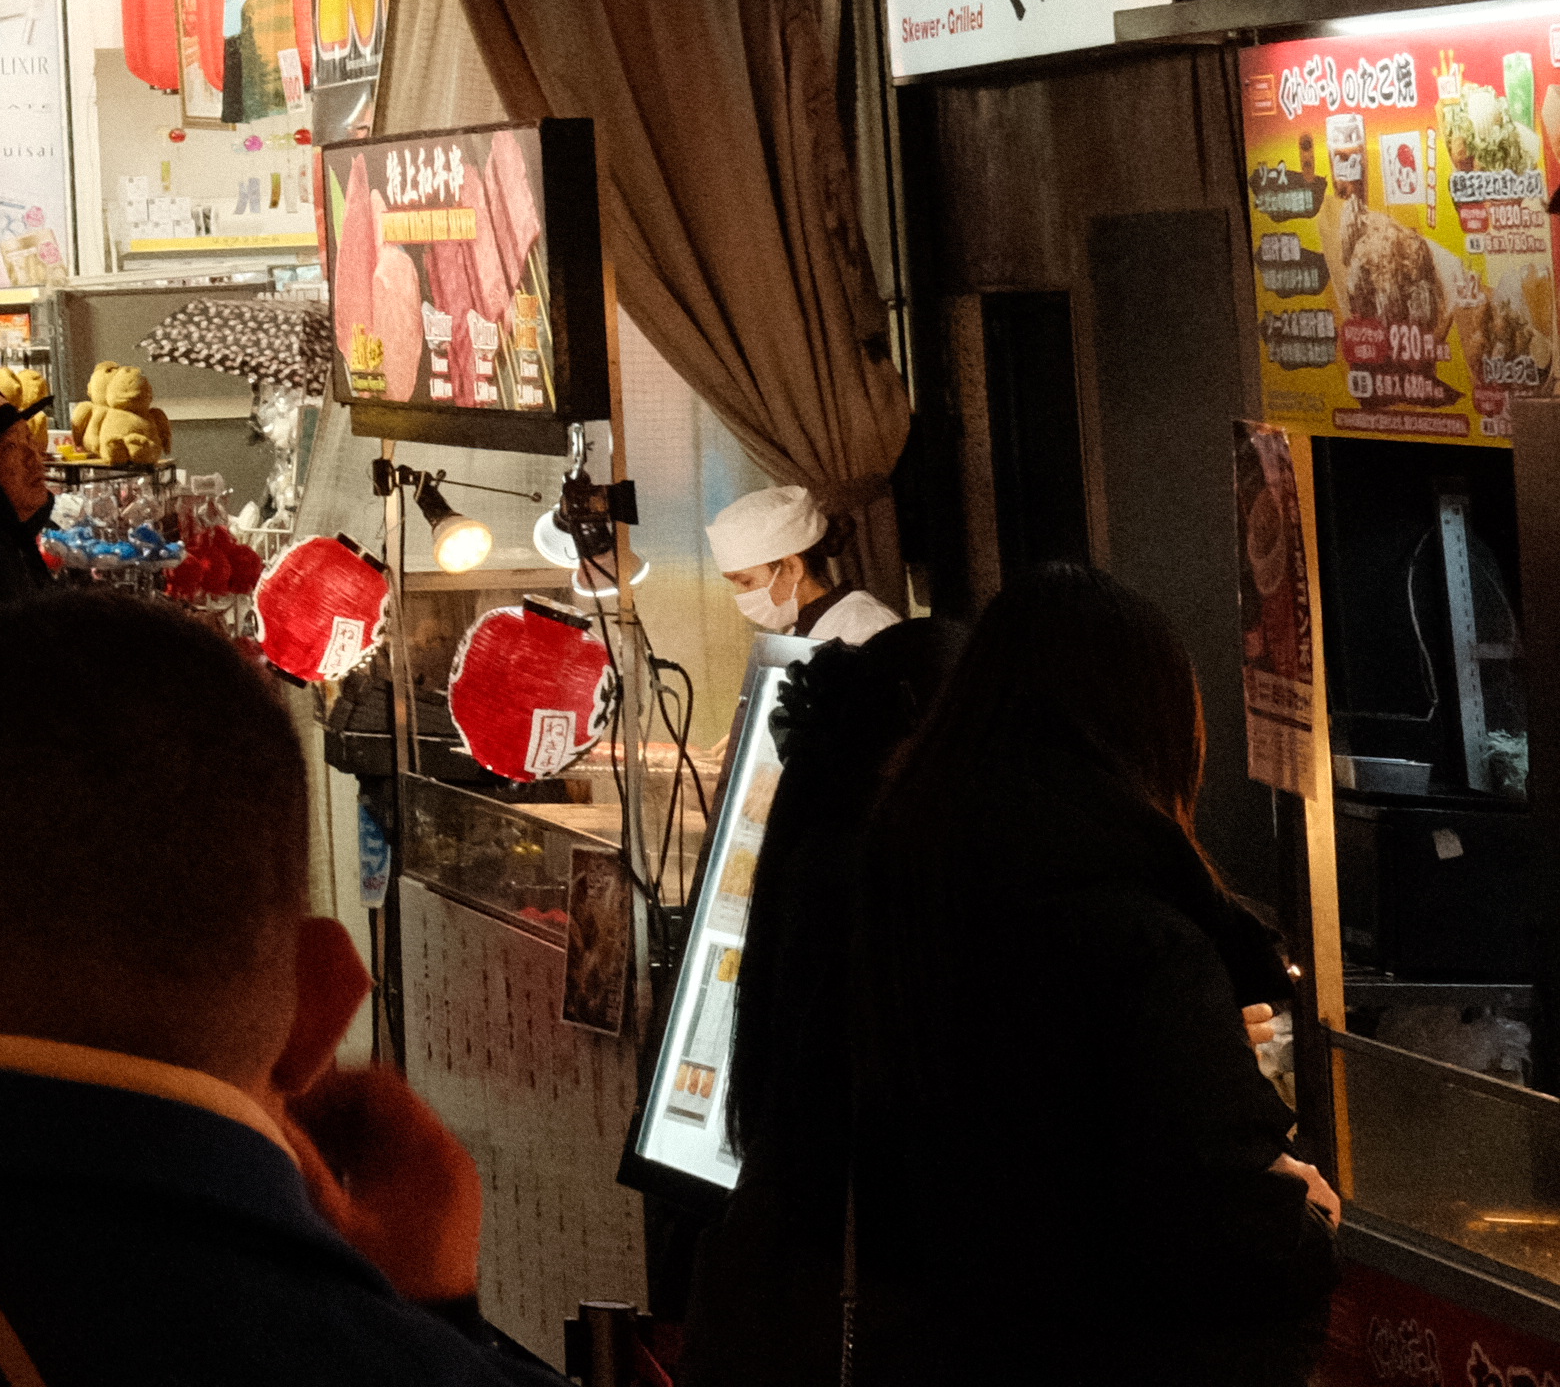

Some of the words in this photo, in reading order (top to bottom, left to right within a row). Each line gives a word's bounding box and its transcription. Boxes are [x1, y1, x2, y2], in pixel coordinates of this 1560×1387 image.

[385, 143, 465, 206] 特上和牛串
